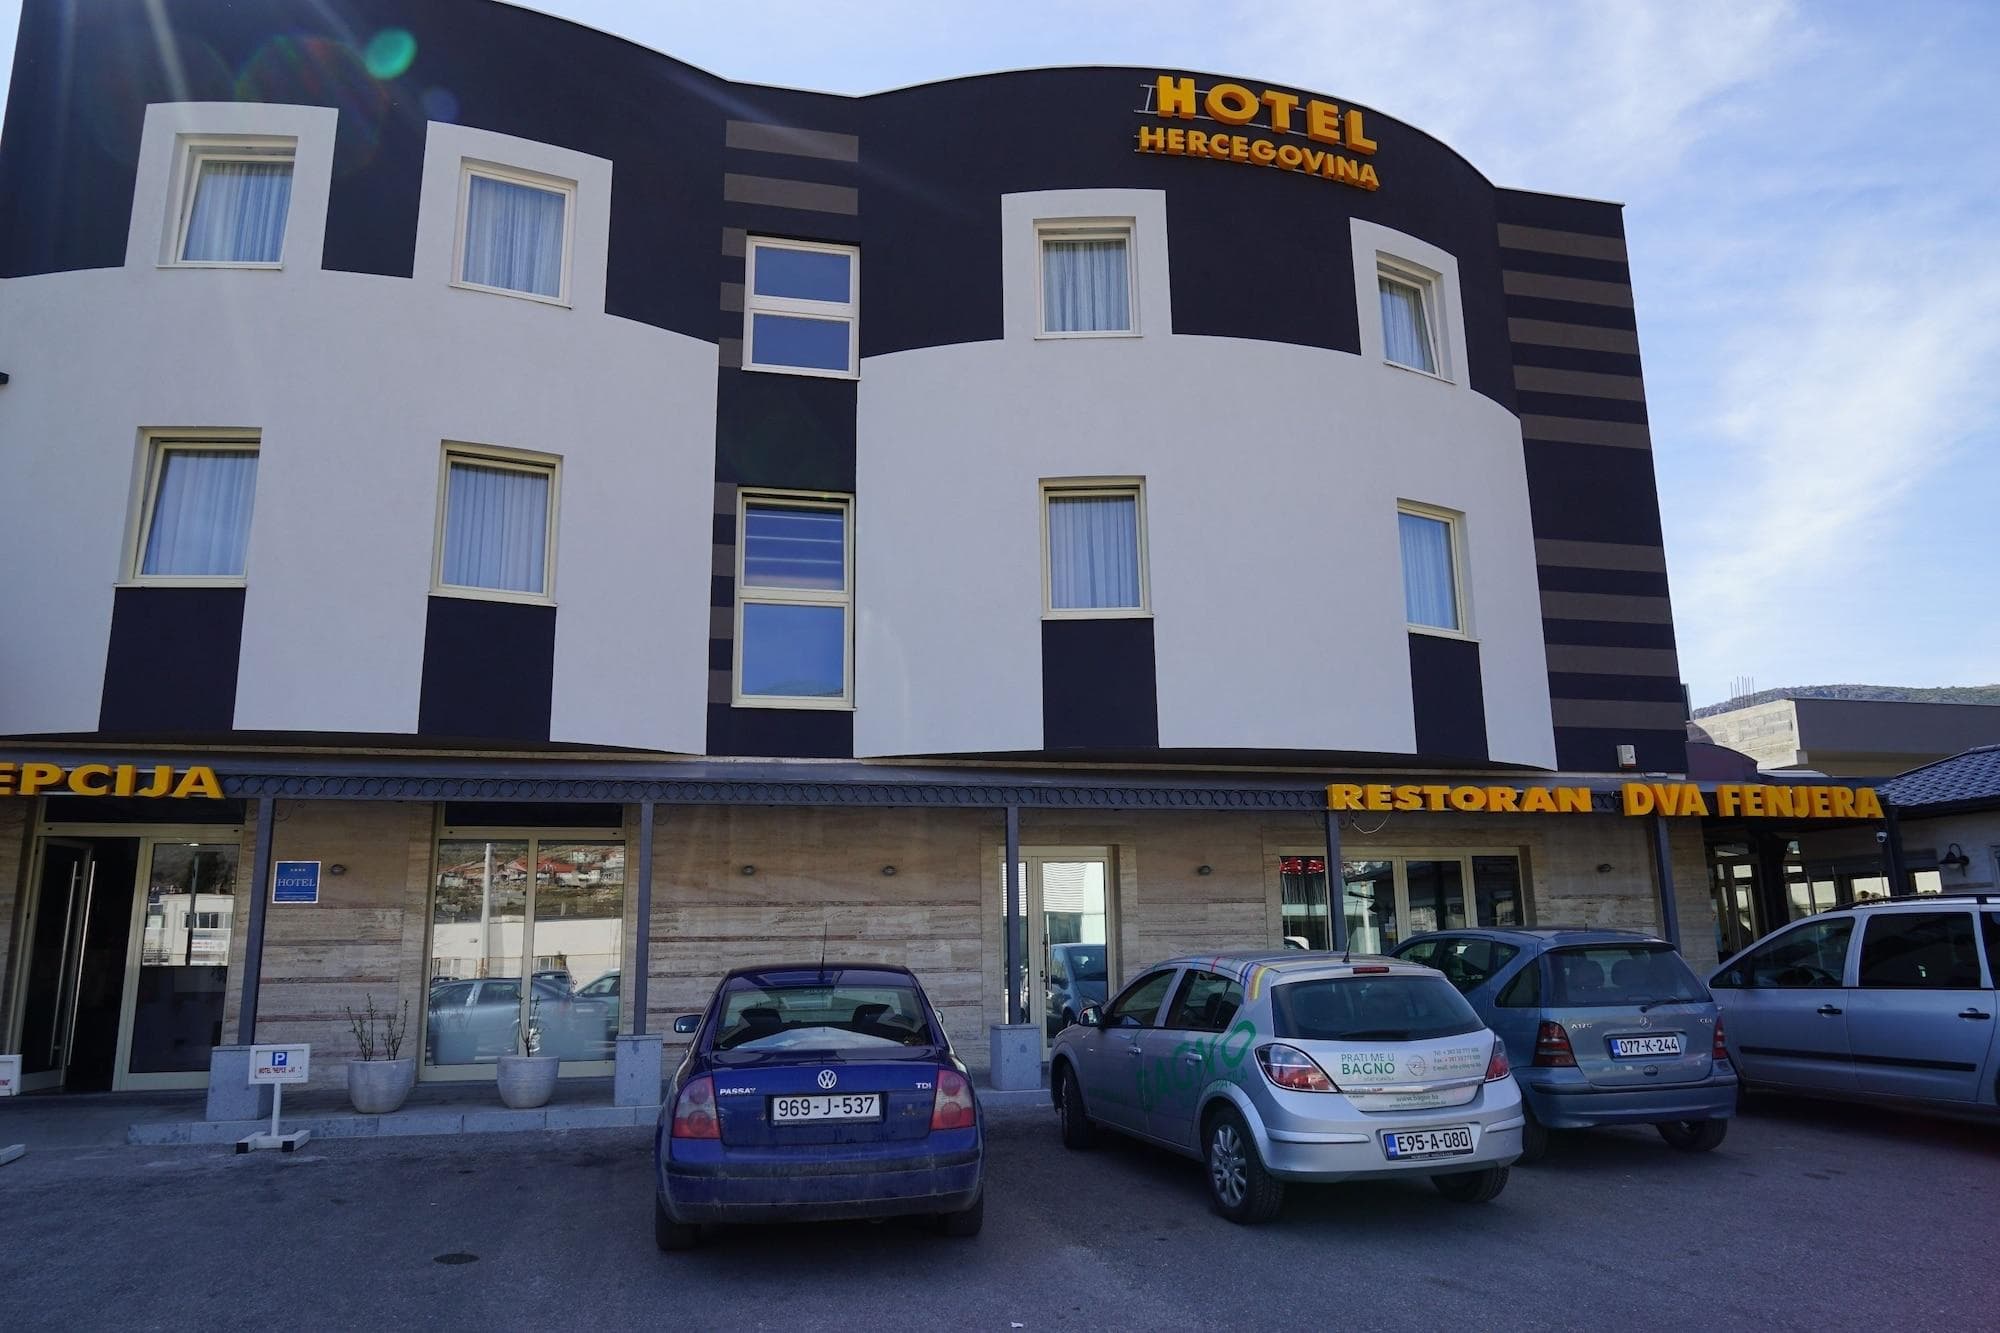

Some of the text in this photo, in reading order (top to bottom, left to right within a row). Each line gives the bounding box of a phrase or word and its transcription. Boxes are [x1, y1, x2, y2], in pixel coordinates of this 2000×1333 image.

[1156, 75, 1378, 155] HOTEL
[1139, 126, 1380, 191] HERCEGOVINA
[1327, 784, 1593, 813] RESTORAN
[1622, 783, 1885, 819] DVA FENJERA
[277, 878, 316, 887] HOTEL
[1620, 1038, 1678, 1054] 077-K-244
[274, 1052, 286, 1065] P
[1341, 1052, 1395, 1062] PRATI ME U
[1341, 1062, 1396, 1075] BAGNO
[916, 1082, 932, 1090] TDI
[778, 1096, 875, 1117] 969-J-537
[1397, 1131, 1469, 1152] E95-A-080
